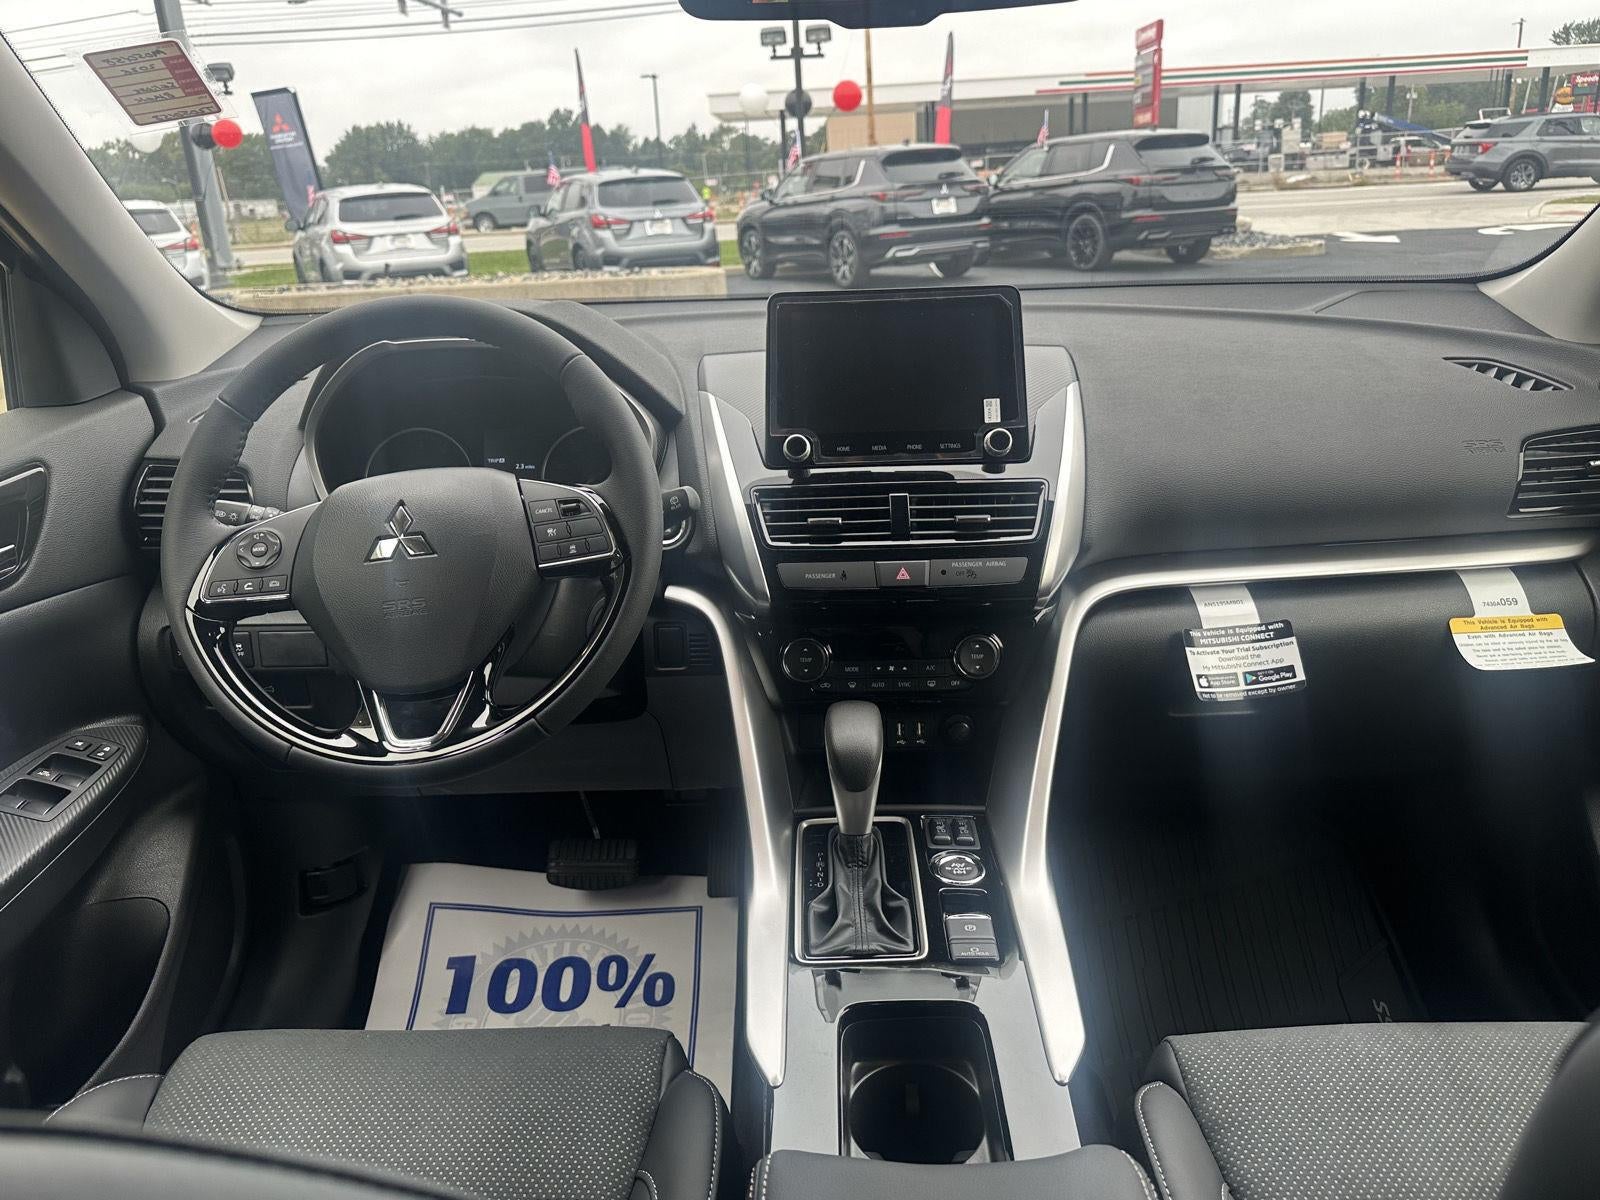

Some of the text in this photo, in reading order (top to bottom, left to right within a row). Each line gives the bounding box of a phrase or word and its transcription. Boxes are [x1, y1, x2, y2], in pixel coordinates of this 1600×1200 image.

[1203, 629, 1226, 637] Vehicle
[1236, 625, 1266, 635] Equipped
[1268, 622, 1284, 630] with
[1200, 632, 1275, 645] MITSUBISHI CONNECT
[1252, 640, 1294, 652] Subscription
[1212, 661, 1241, 670] Mitsubishi
[1242, 659, 1269, 668] Connect
[1270, 657, 1284, 665] App
[1218, 653, 1261, 663] Download the
[1258, 671, 1293, 682] Google Play
[1223, 690, 1247, 698] removed
[1248, 688, 1268, 697] except
[1268, 686, 1276, 694] by
[1277, 684, 1296, 692] owner
[445, 953, 675, 1015] 100%
